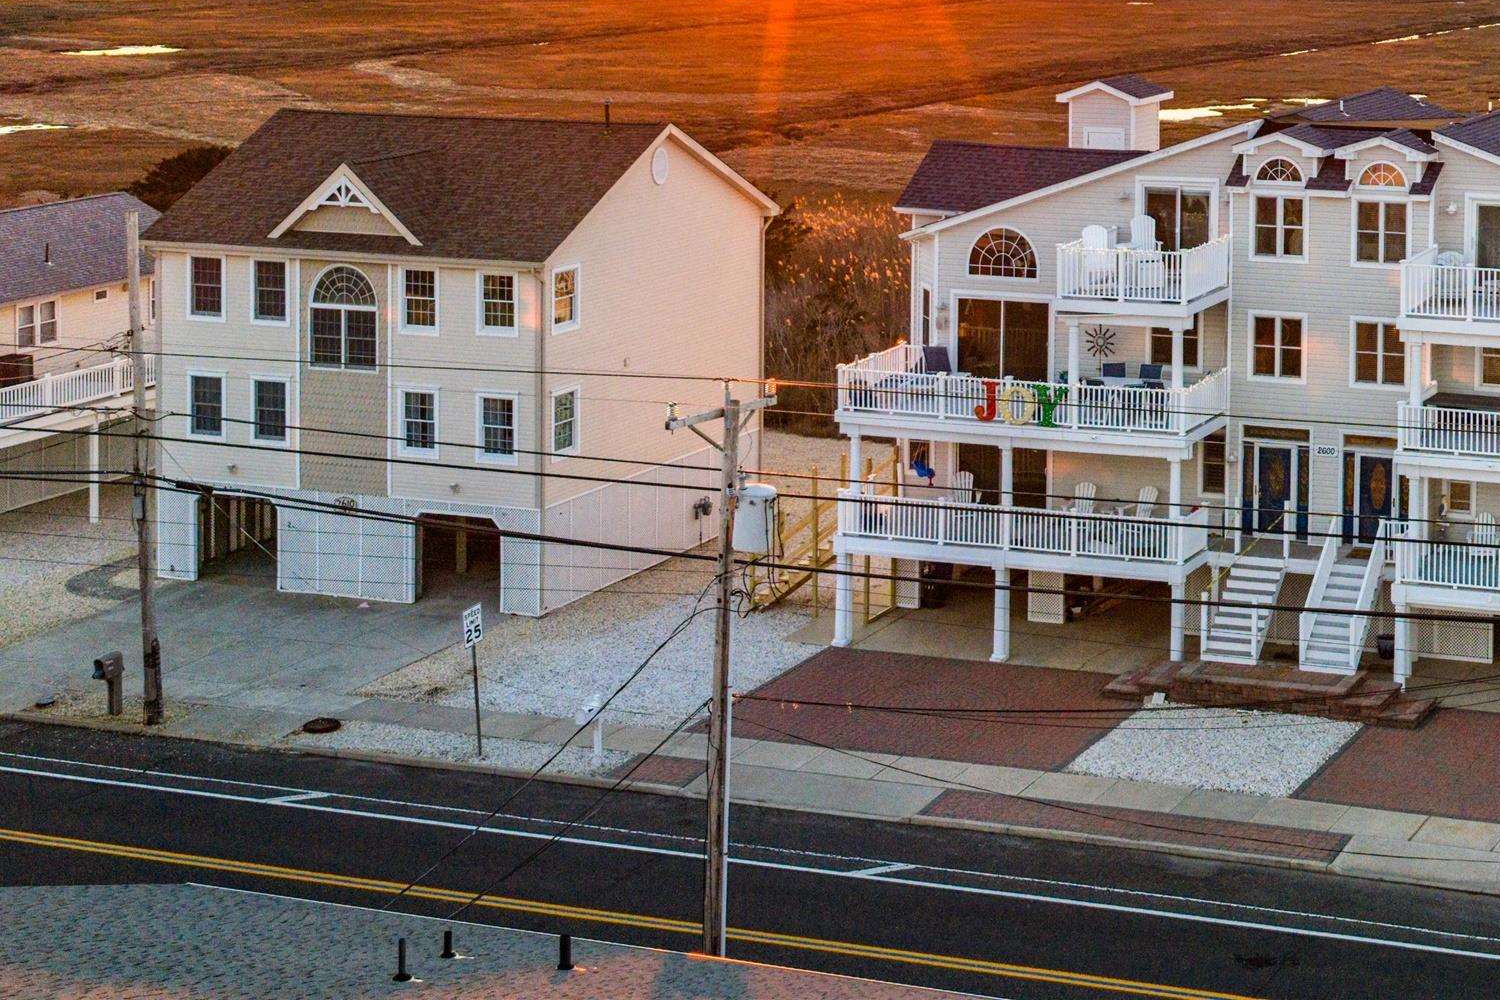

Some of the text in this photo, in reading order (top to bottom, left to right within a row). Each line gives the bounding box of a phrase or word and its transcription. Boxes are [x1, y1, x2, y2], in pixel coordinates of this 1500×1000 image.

[974, 381, 1070, 428] JOY
[1317, 446, 1335, 455] 2600
[464, 607, 480, 620] SPEED
[465, 615, 480, 628] LIMIT
[465, 623, 482, 644] 25
